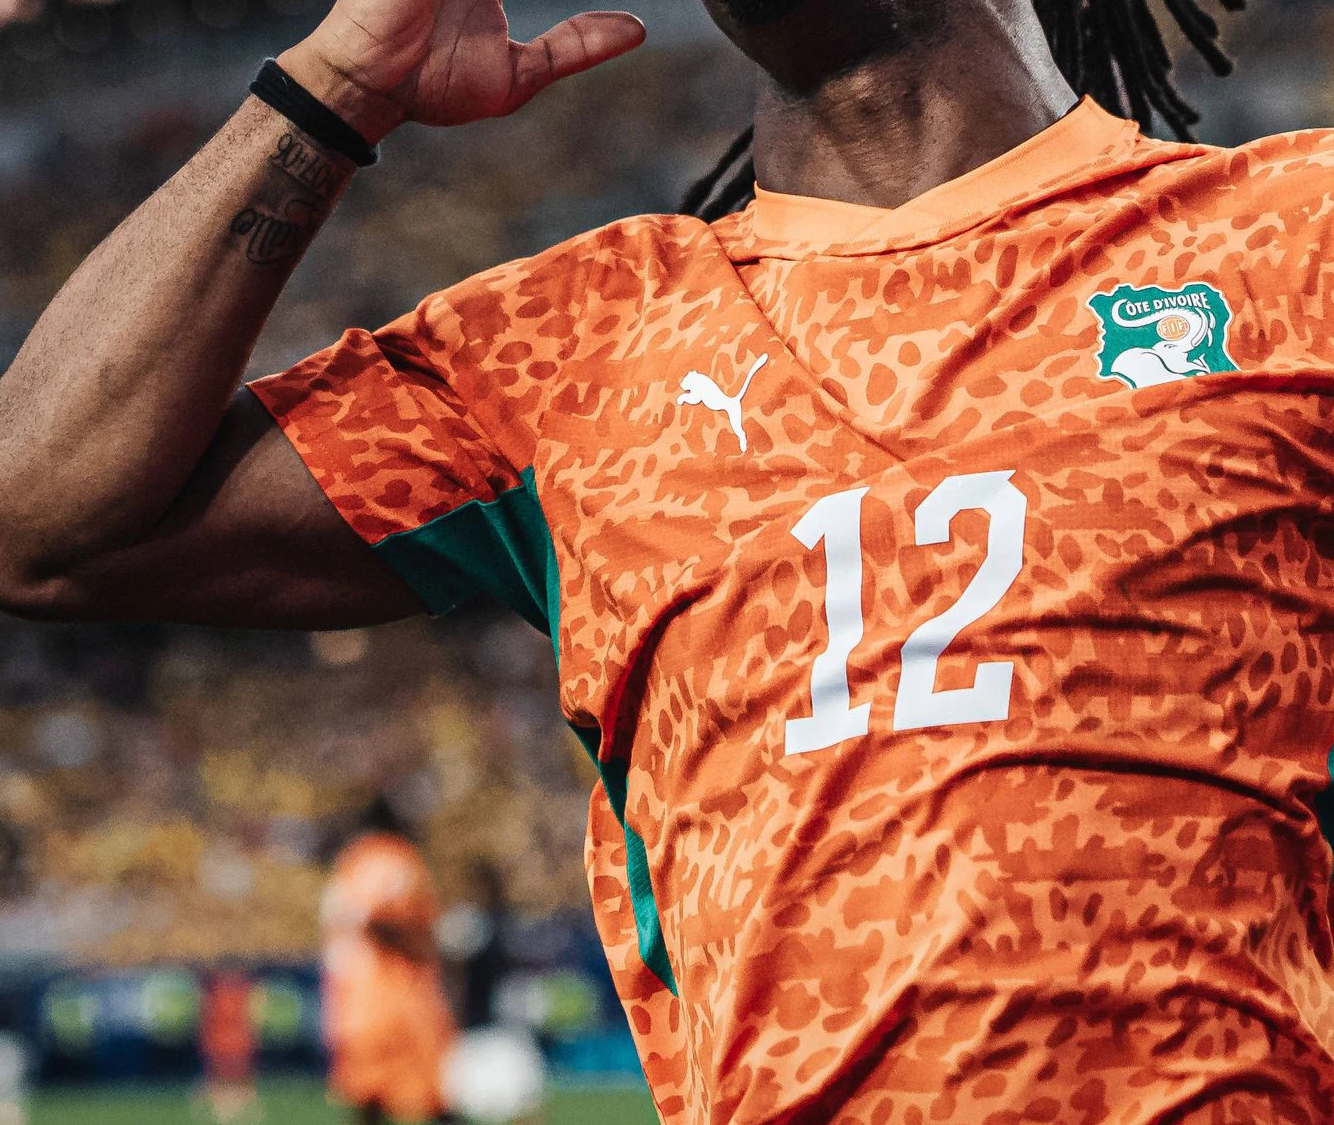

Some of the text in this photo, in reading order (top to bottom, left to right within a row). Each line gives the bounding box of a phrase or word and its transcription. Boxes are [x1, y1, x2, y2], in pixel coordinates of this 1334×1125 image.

[1112, 292, 1211, 326] CÔTE D'IVOIRE
[1162, 321, 1186, 336] FIF
[785, 470, 1027, 755] 12
